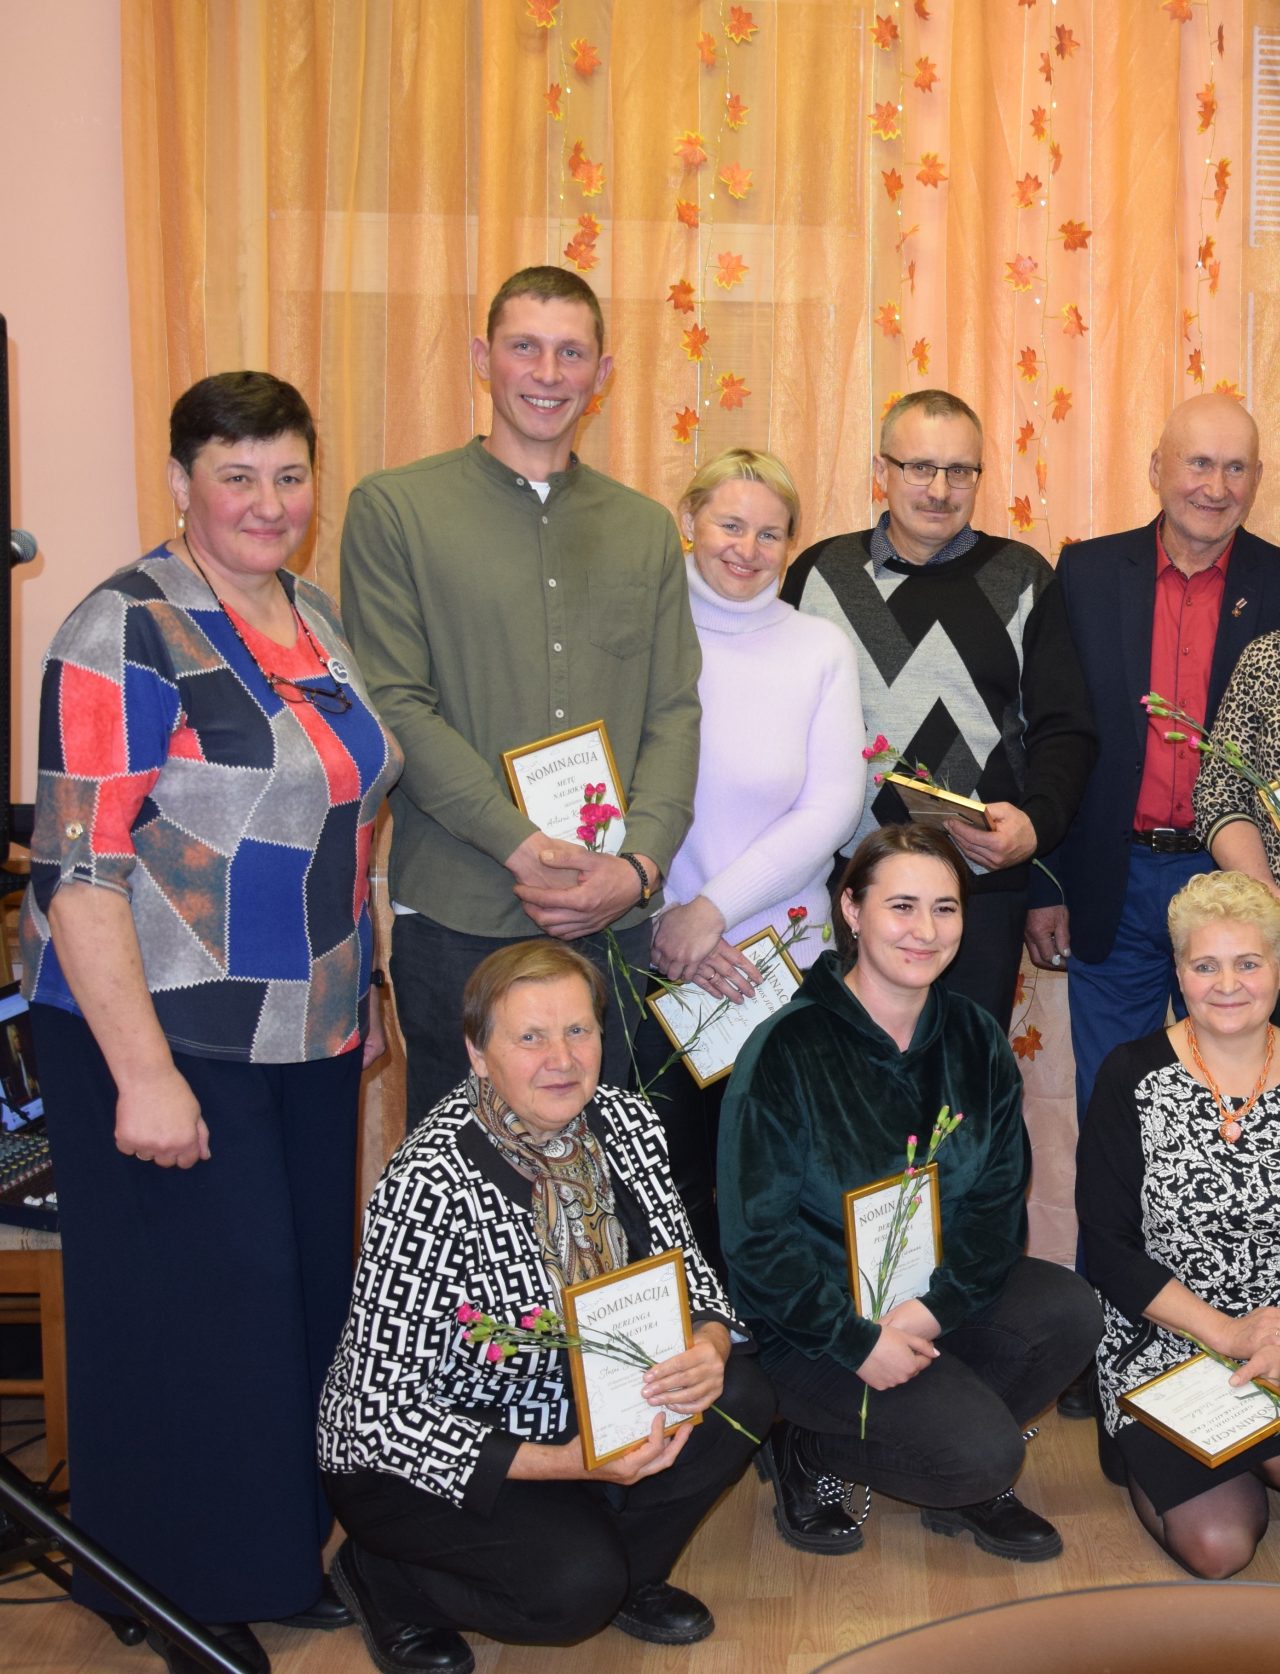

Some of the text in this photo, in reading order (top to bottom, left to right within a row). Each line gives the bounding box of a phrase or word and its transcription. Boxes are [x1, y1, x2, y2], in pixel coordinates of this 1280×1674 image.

[526, 751, 598, 785] NOMINACIJA
[586, 1285, 669, 1326] NOMINACIJA
[611, 1312, 651, 1331] DERLINGA
